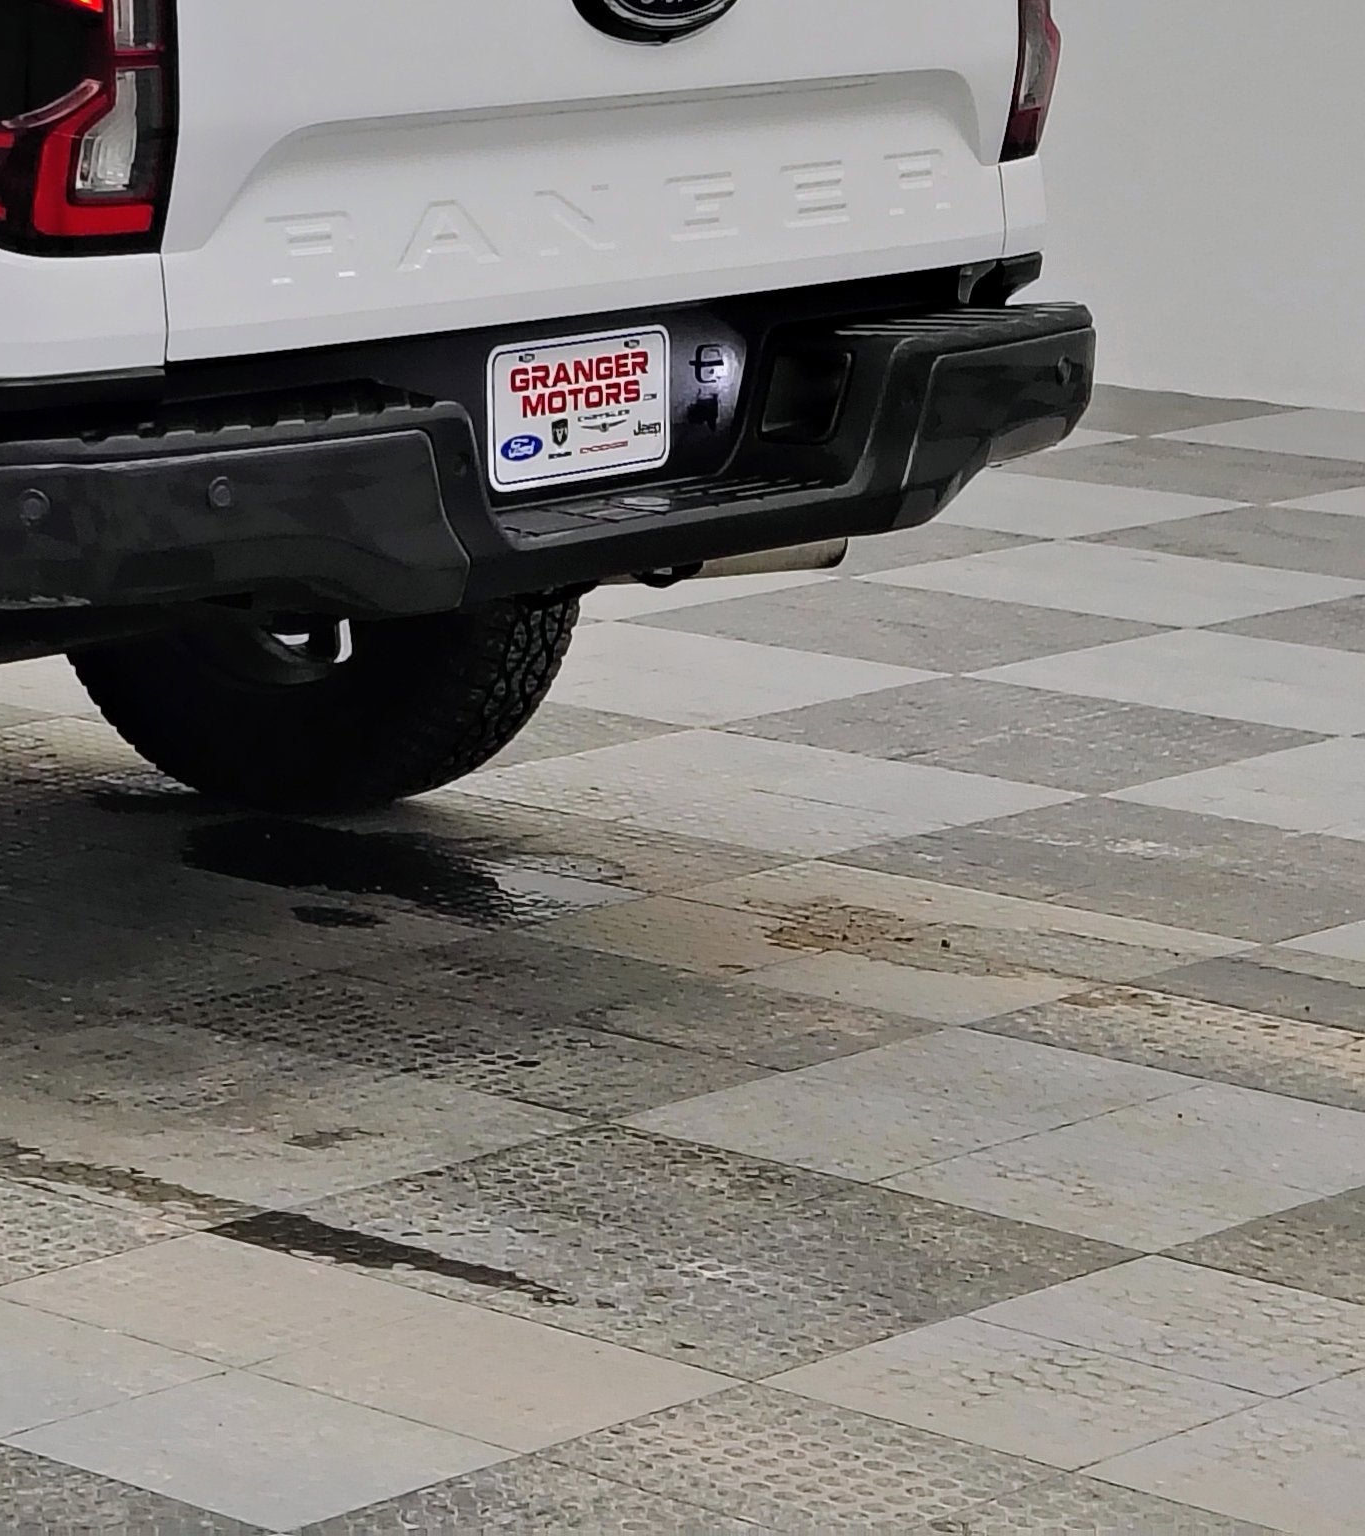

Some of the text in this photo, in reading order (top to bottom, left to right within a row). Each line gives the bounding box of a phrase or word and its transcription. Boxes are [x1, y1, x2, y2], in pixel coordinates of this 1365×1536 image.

[264, 148, 952, 286] RANGER
[510, 350, 649, 393] GRANGER
[521, 379, 641, 418] MOTORS
